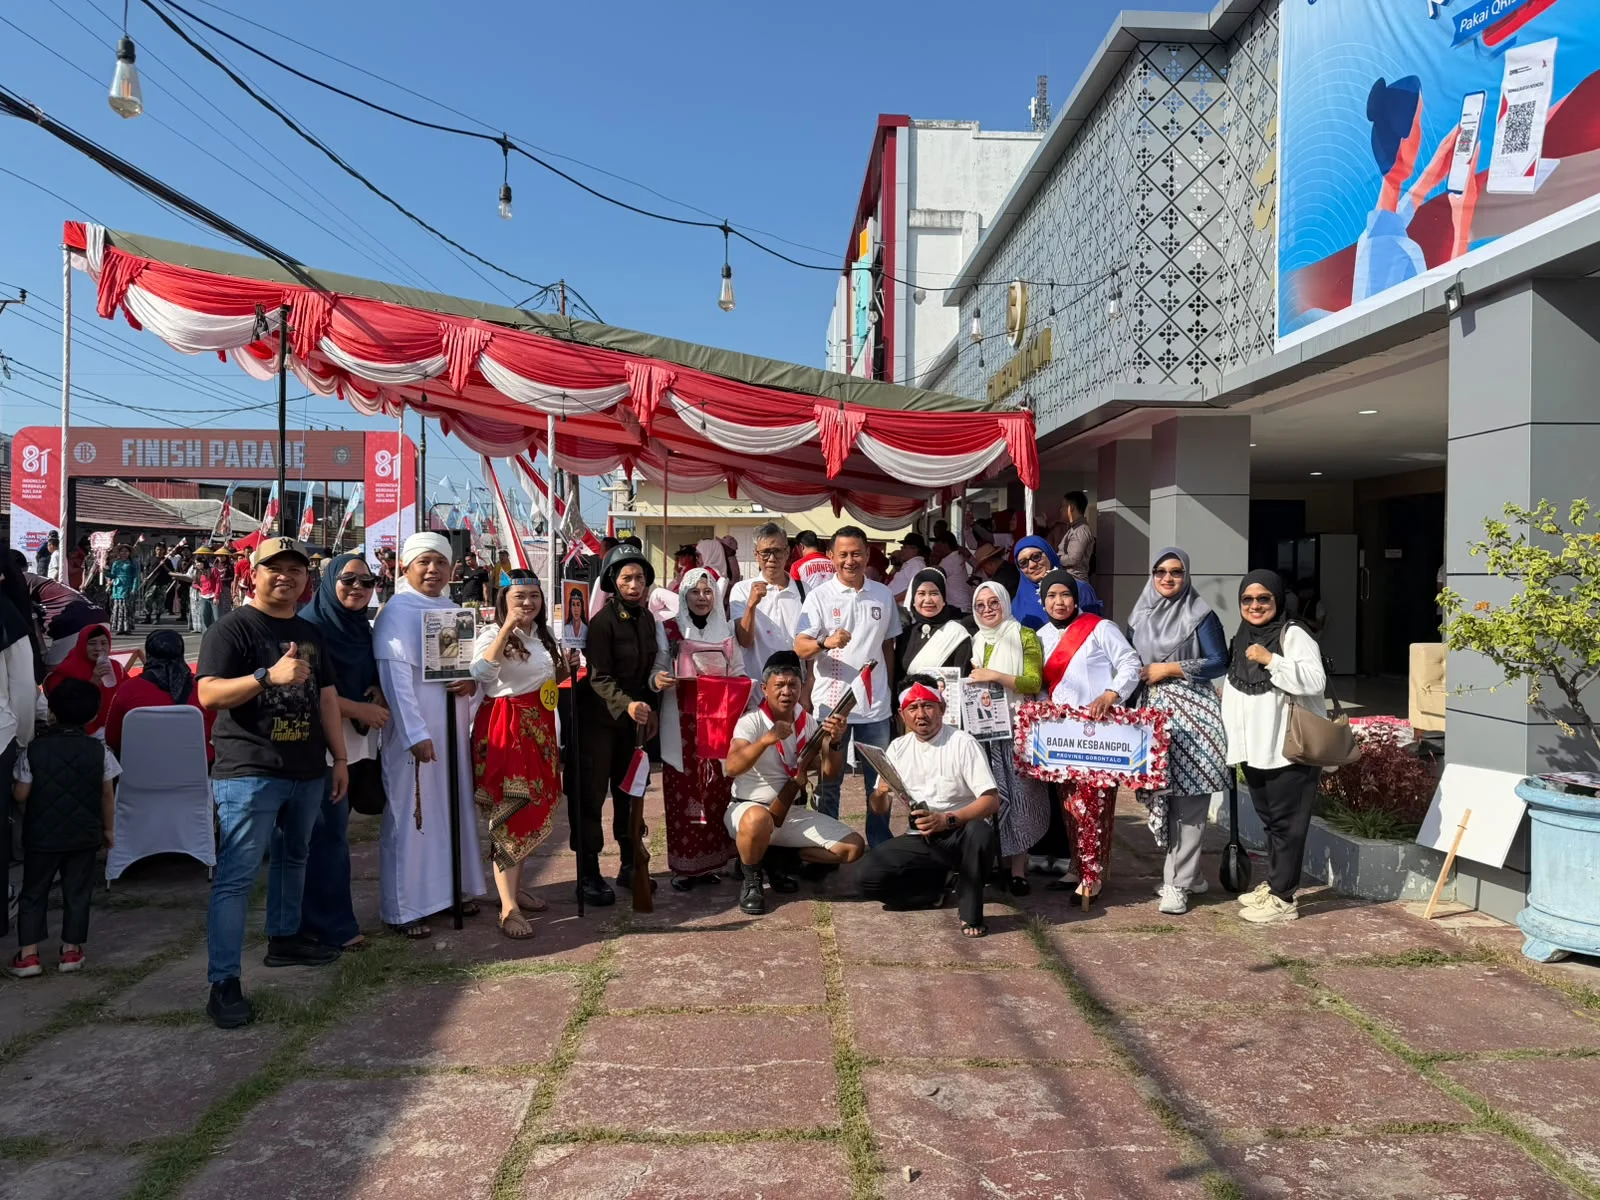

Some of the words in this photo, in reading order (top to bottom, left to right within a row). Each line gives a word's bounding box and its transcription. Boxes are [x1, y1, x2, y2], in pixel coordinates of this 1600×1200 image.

[1460, 6, 1489, 32] Pakai
[22, 445, 52, 477] 81
[122, 439, 200, 467] FINISH
[209, 440, 306, 468] PARADE
[375, 450, 400, 480] 81
[543, 689, 556, 706] 28
[272, 716, 289, 729] The
[1046, 737, 1075, 748] BADAN
[1077, 739, 1132, 752] KESBANGPOL
[1085, 753, 1122, 763] GORONTALO
